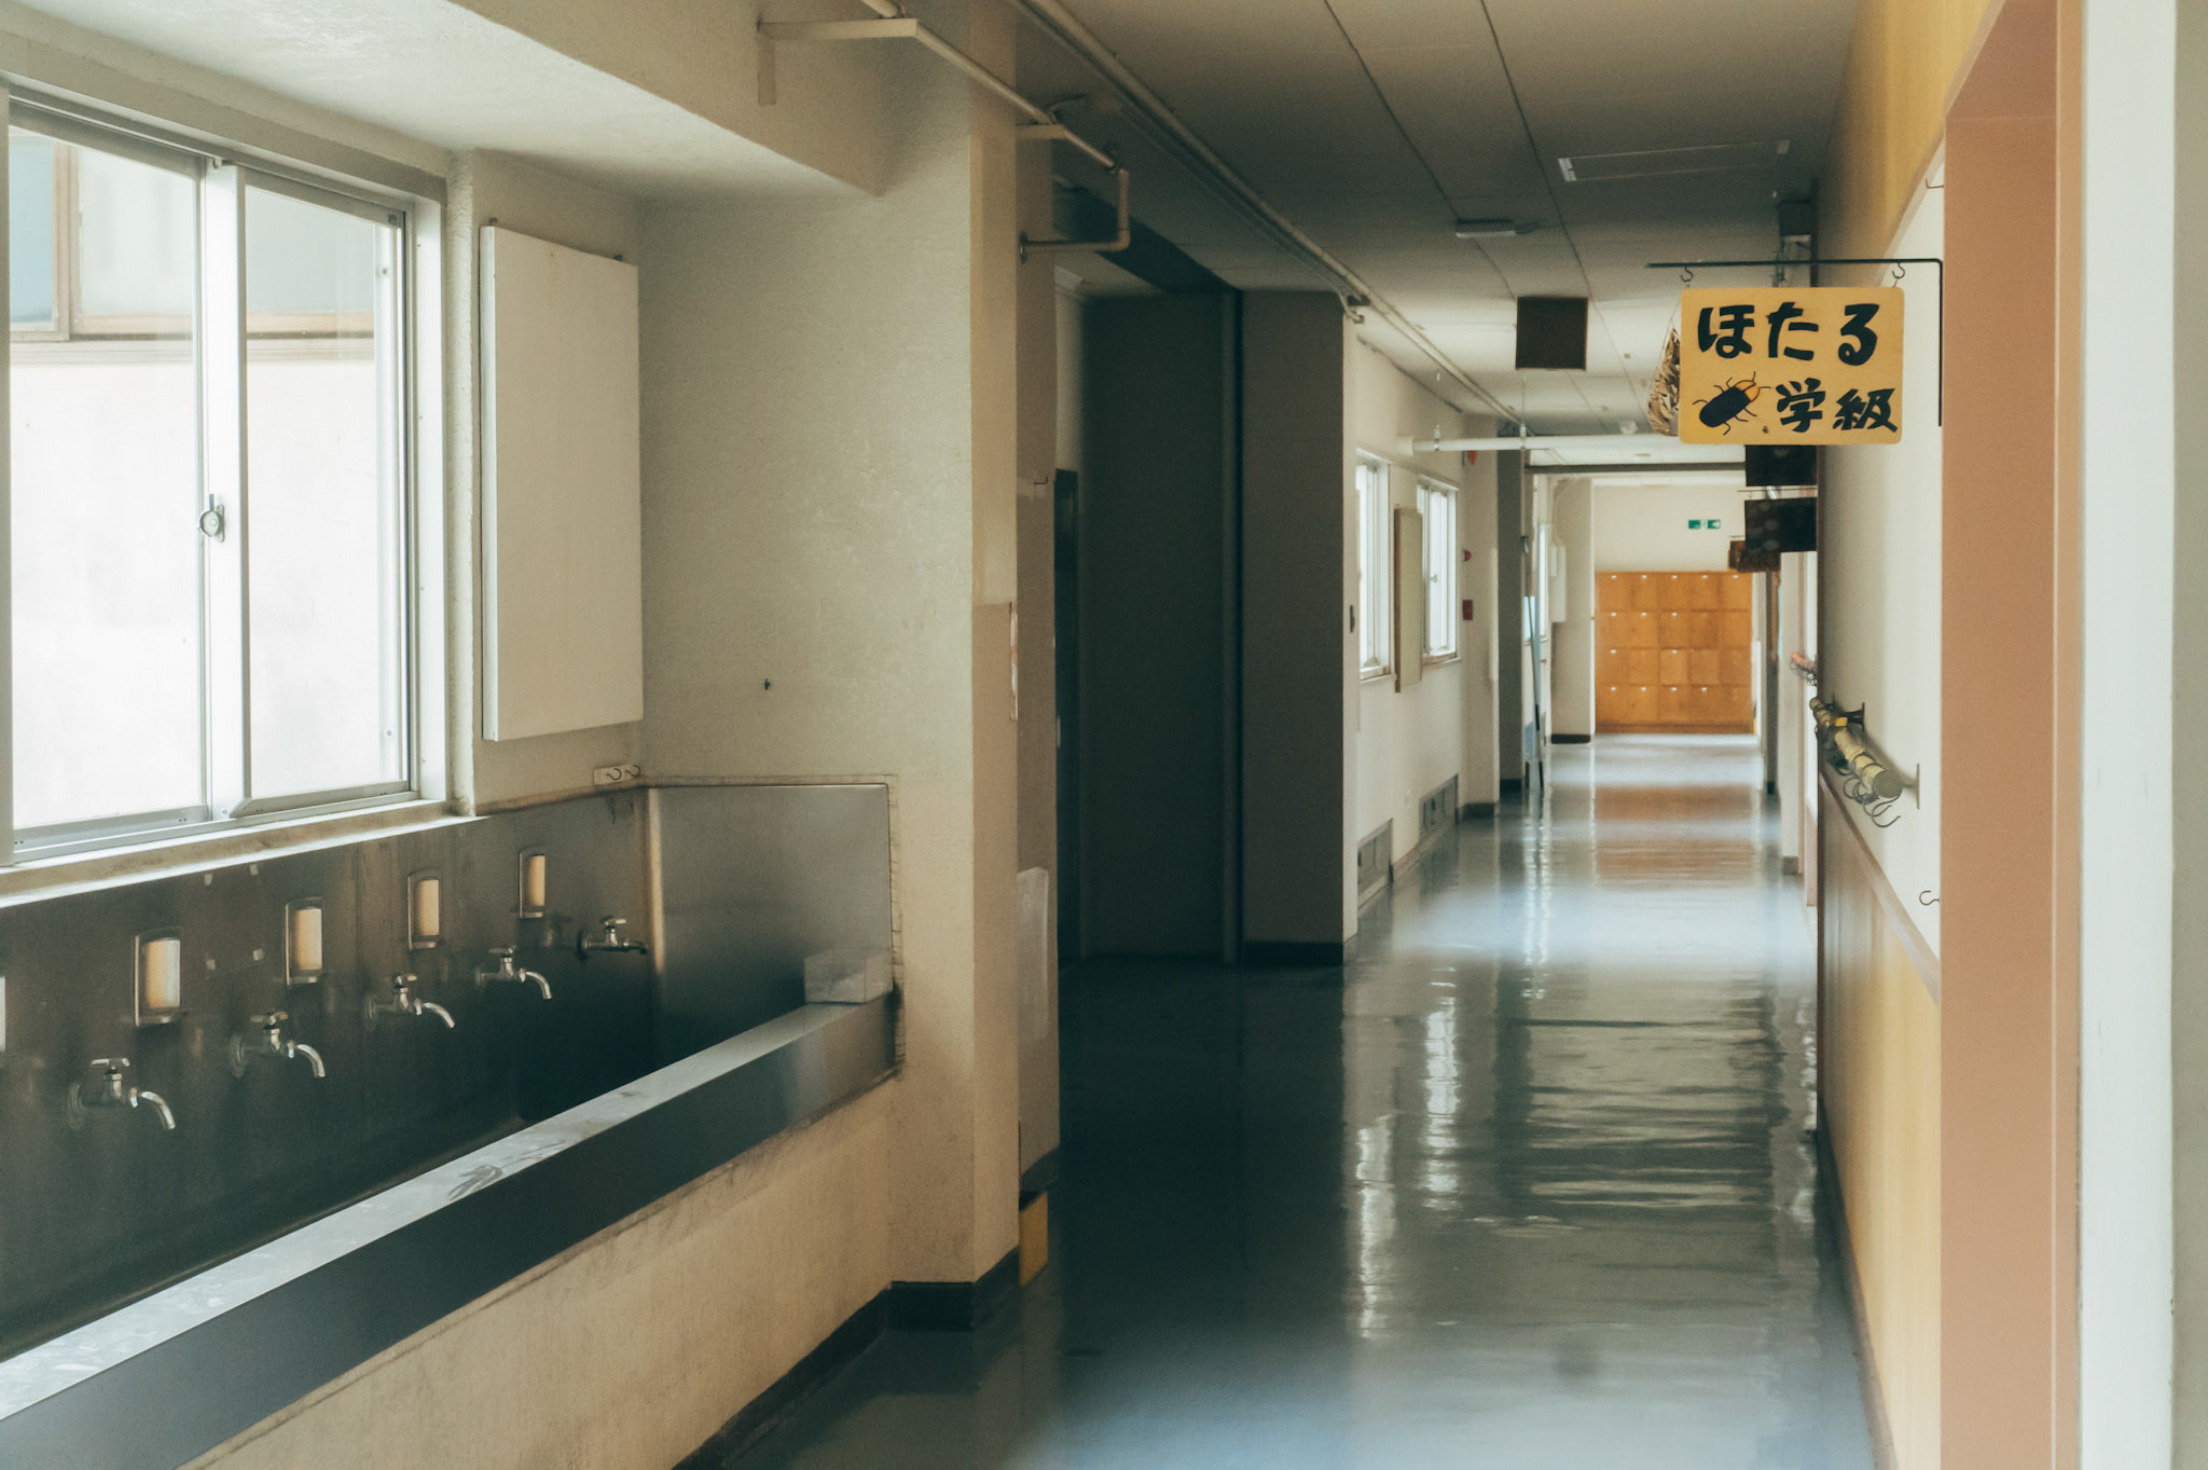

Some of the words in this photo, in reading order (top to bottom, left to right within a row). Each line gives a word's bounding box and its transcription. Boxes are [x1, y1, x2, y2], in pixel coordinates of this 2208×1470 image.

[1697, 302, 1880, 366] ほたる
[1776, 378, 1898, 433] 学級
